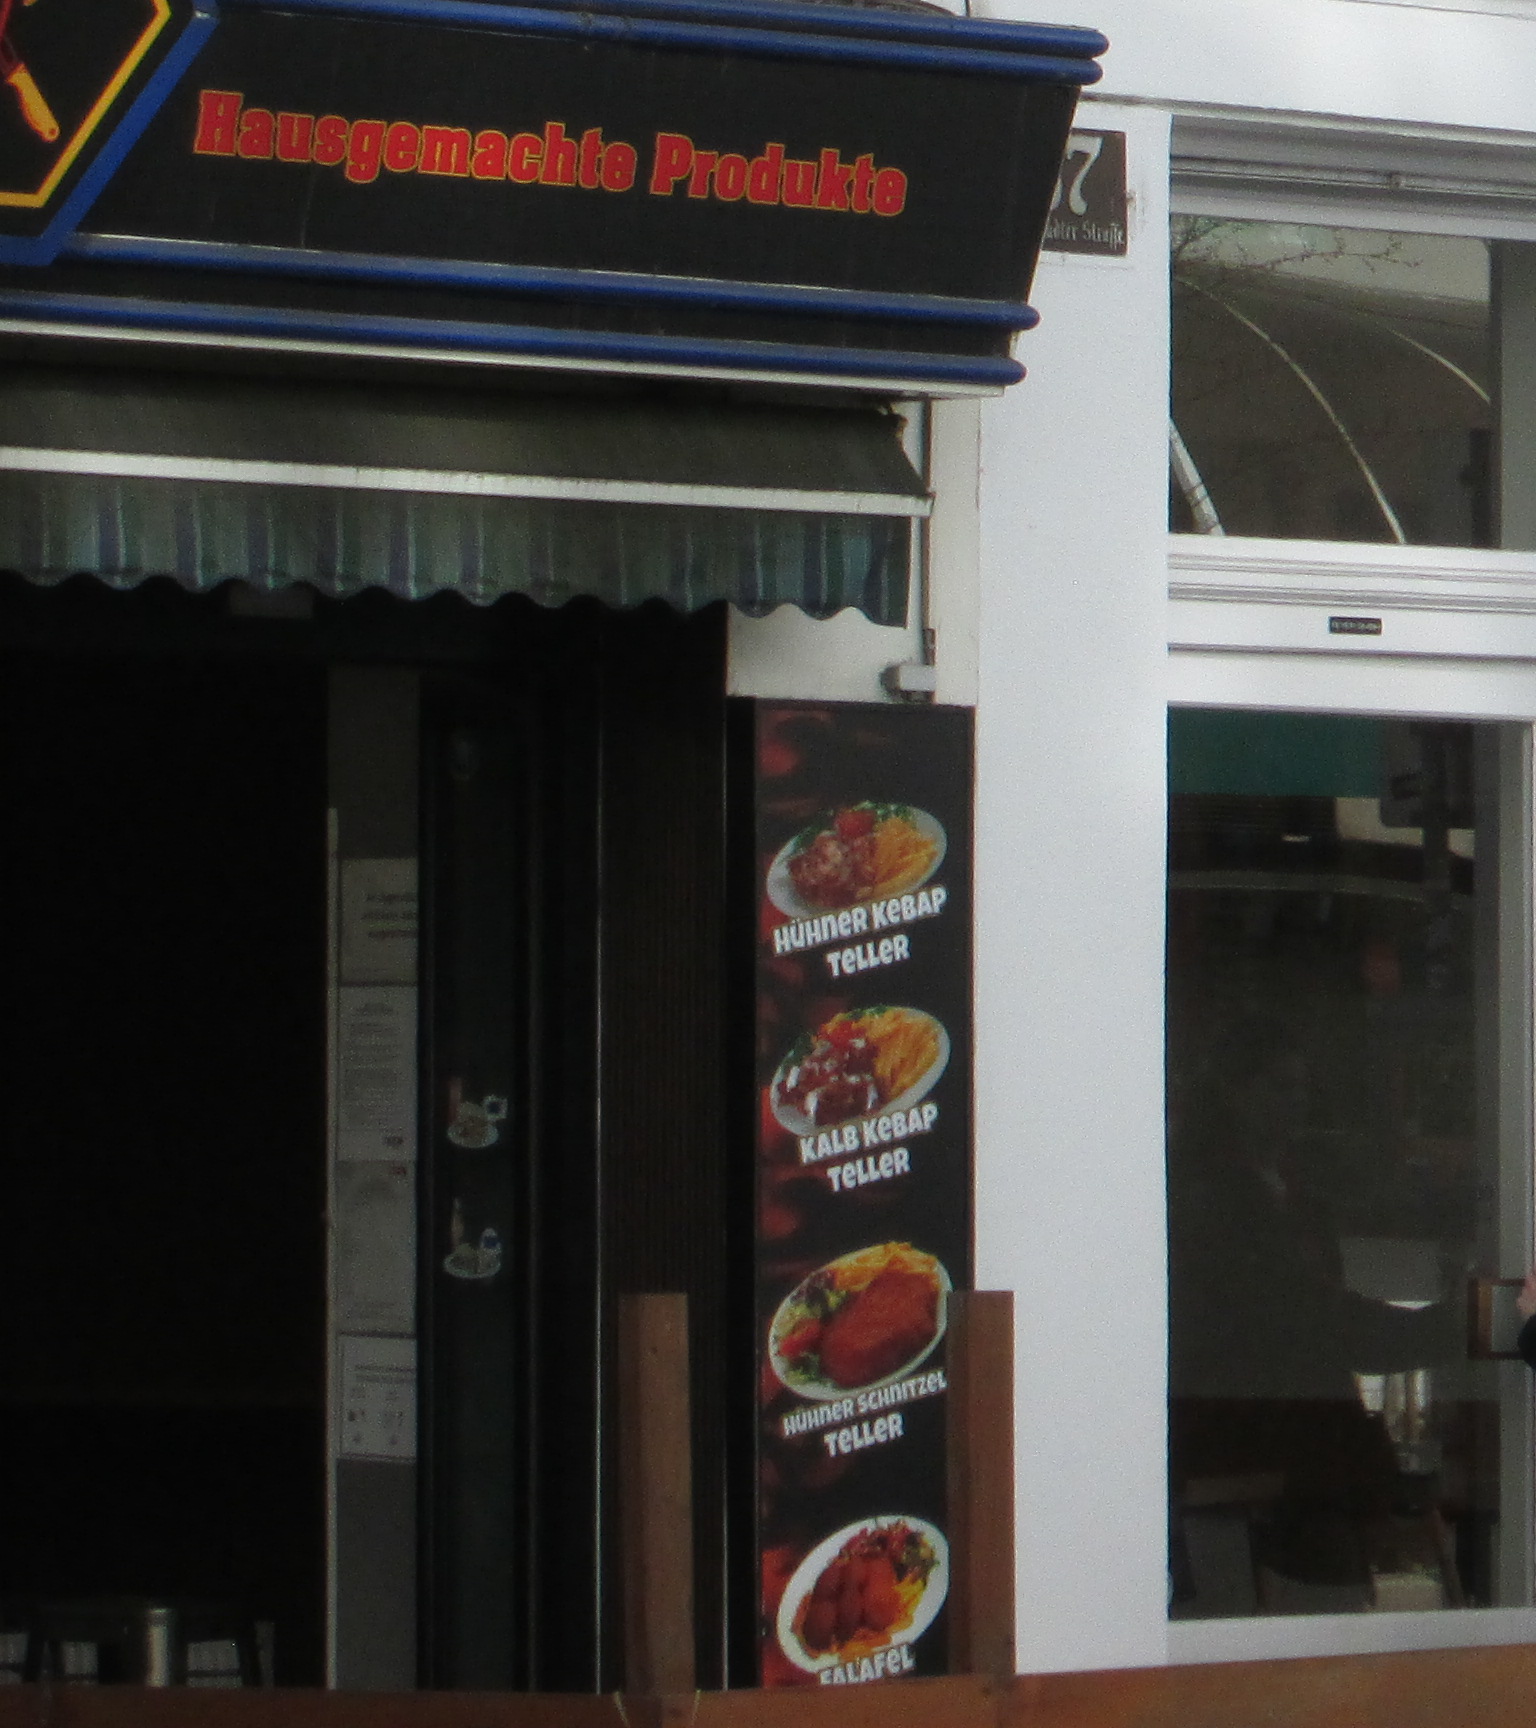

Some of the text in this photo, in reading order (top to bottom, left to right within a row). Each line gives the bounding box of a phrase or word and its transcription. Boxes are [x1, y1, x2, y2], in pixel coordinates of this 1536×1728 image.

[193, 90, 907, 217] Hausgemachte Produkte
[800, 1124, 861, 1164] KALB
